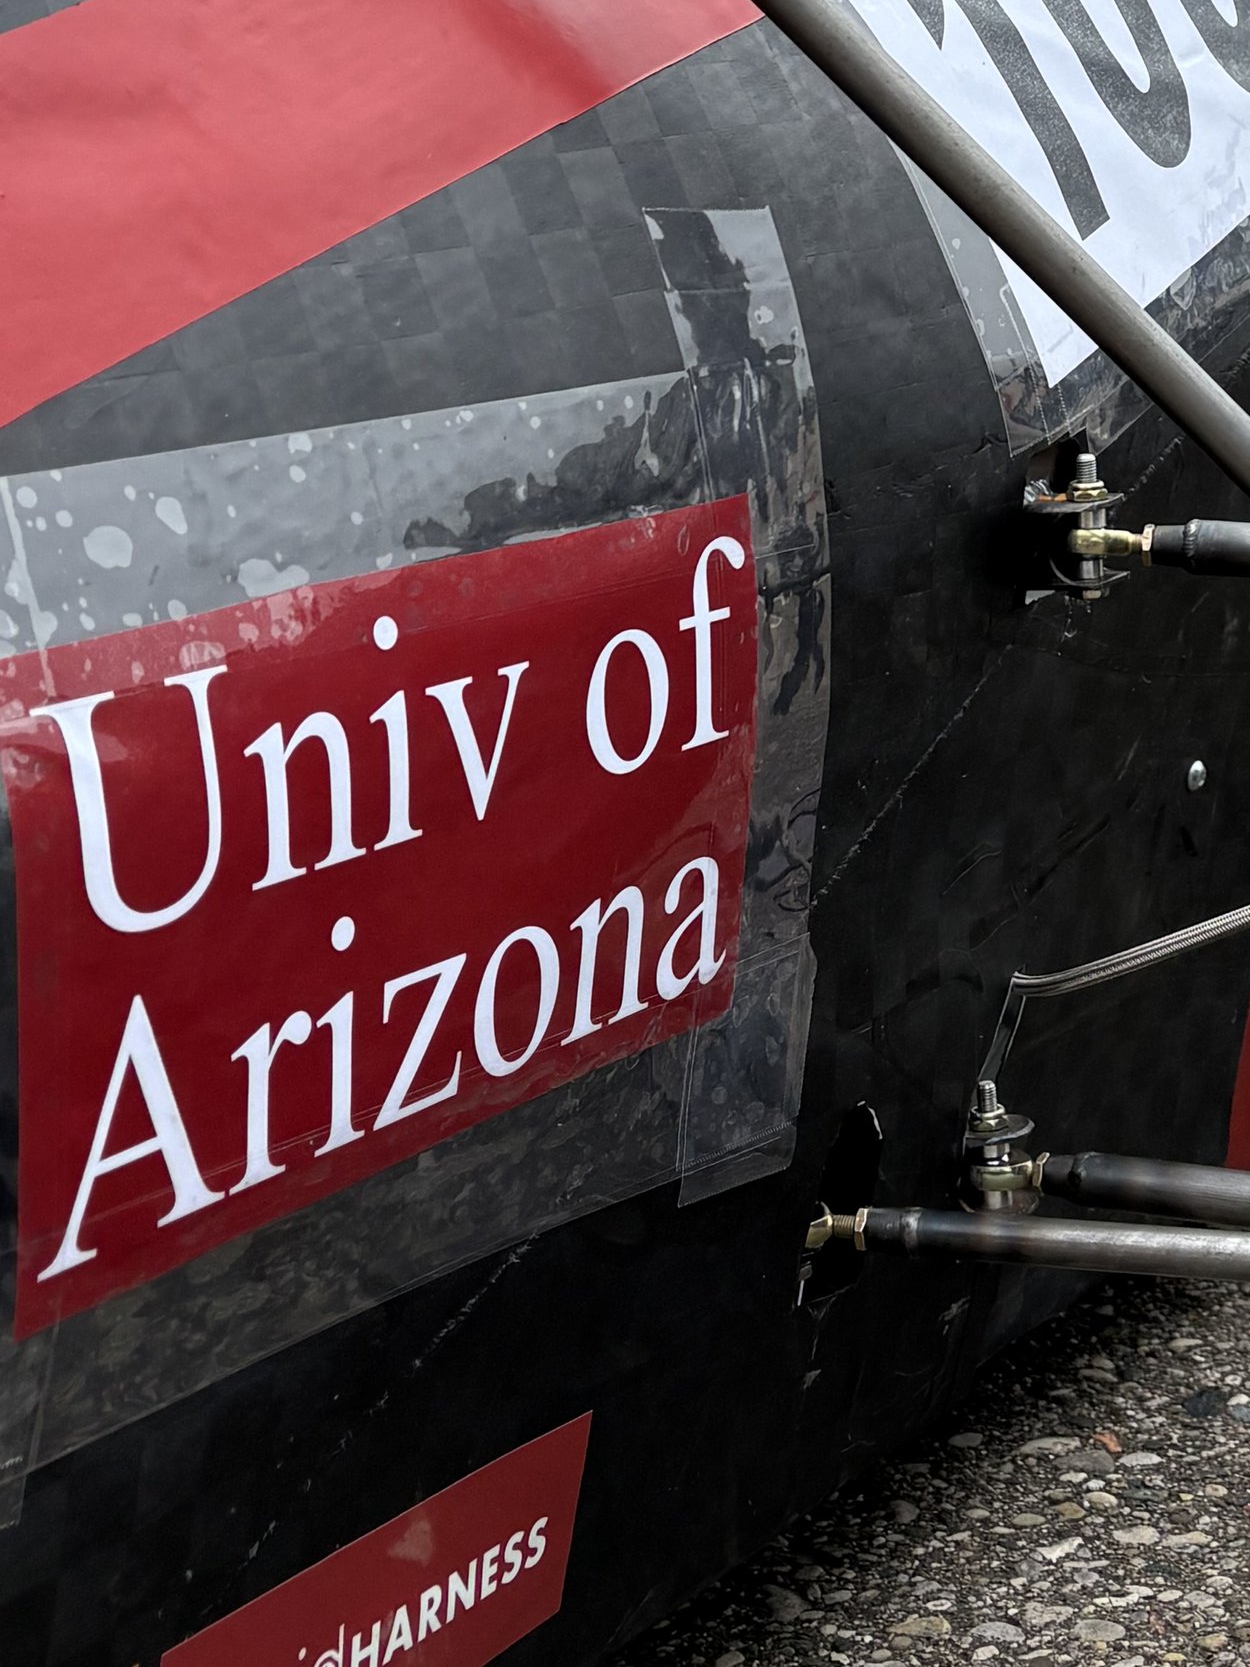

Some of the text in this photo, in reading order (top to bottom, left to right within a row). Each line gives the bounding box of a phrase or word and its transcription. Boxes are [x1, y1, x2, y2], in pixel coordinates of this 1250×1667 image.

[30, 536, 746, 934] Univ of
[36, 854, 727, 1283] Arizona
